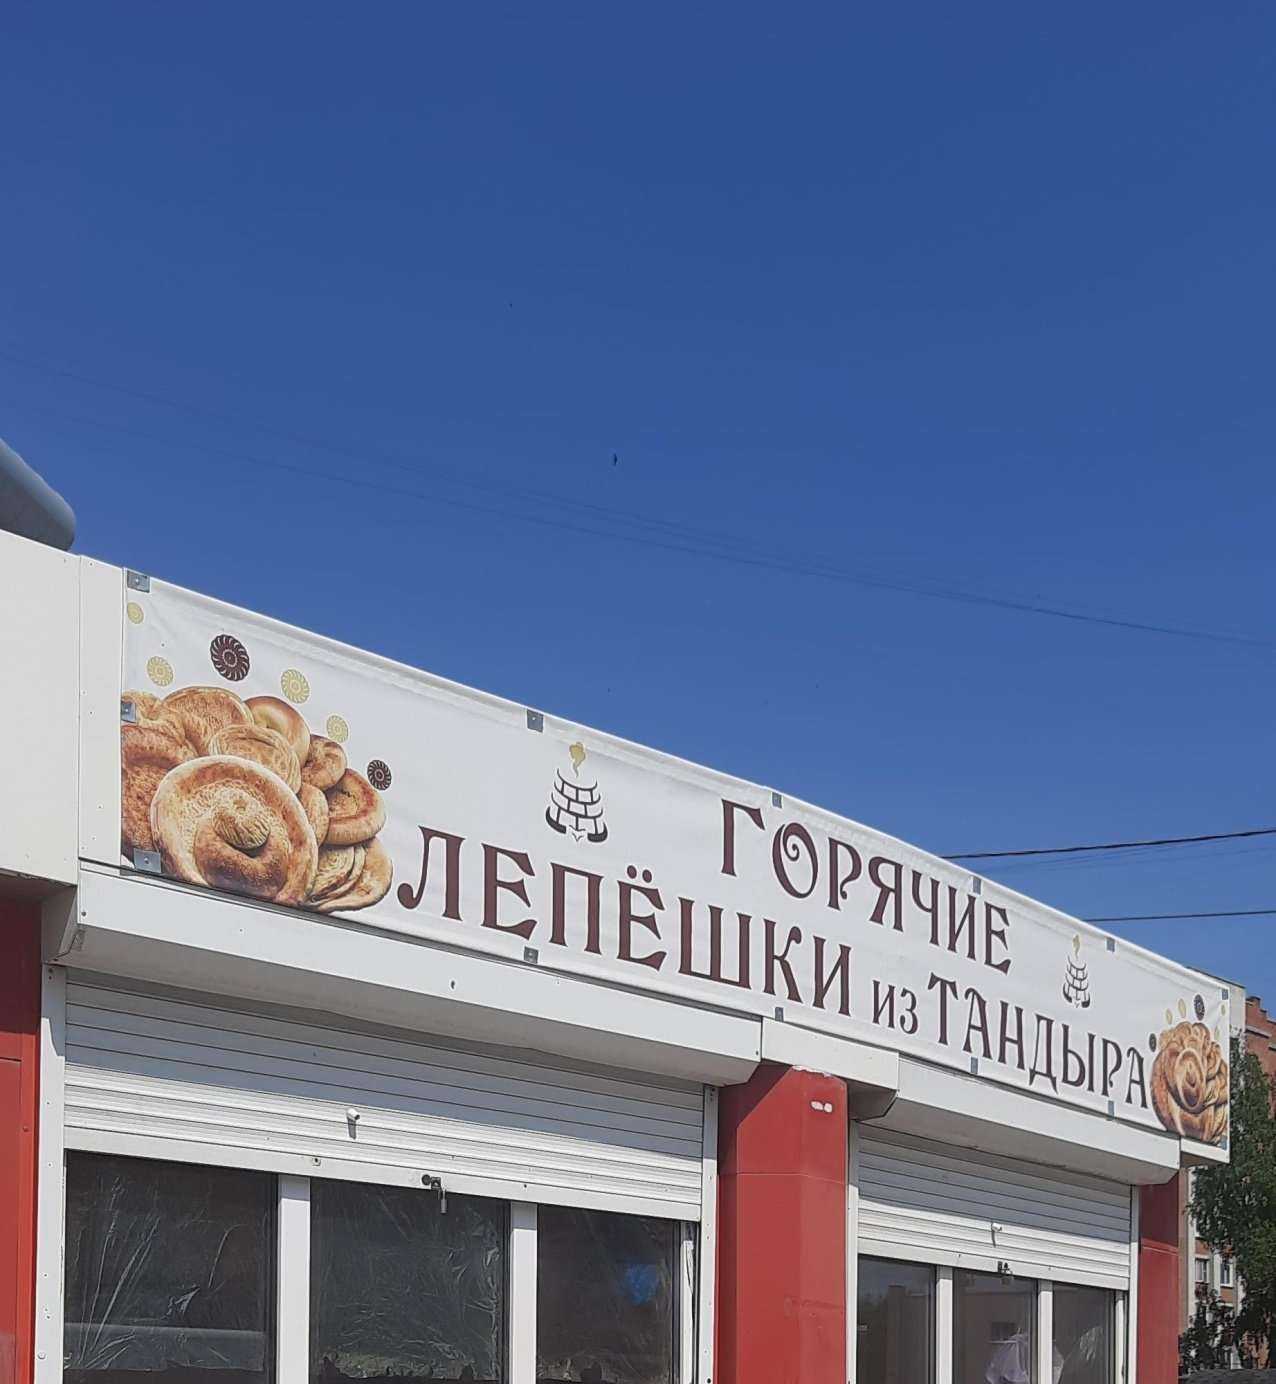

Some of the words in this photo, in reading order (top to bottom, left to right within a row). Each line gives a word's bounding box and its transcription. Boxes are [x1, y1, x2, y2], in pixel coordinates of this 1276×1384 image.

[397, 826, 852, 1017] ЛЕПЁШКИ
[927, 972, 1148, 1109] ТАНДЫРА
[720, 799, 1012, 975] ГОРЯЧИЕ
